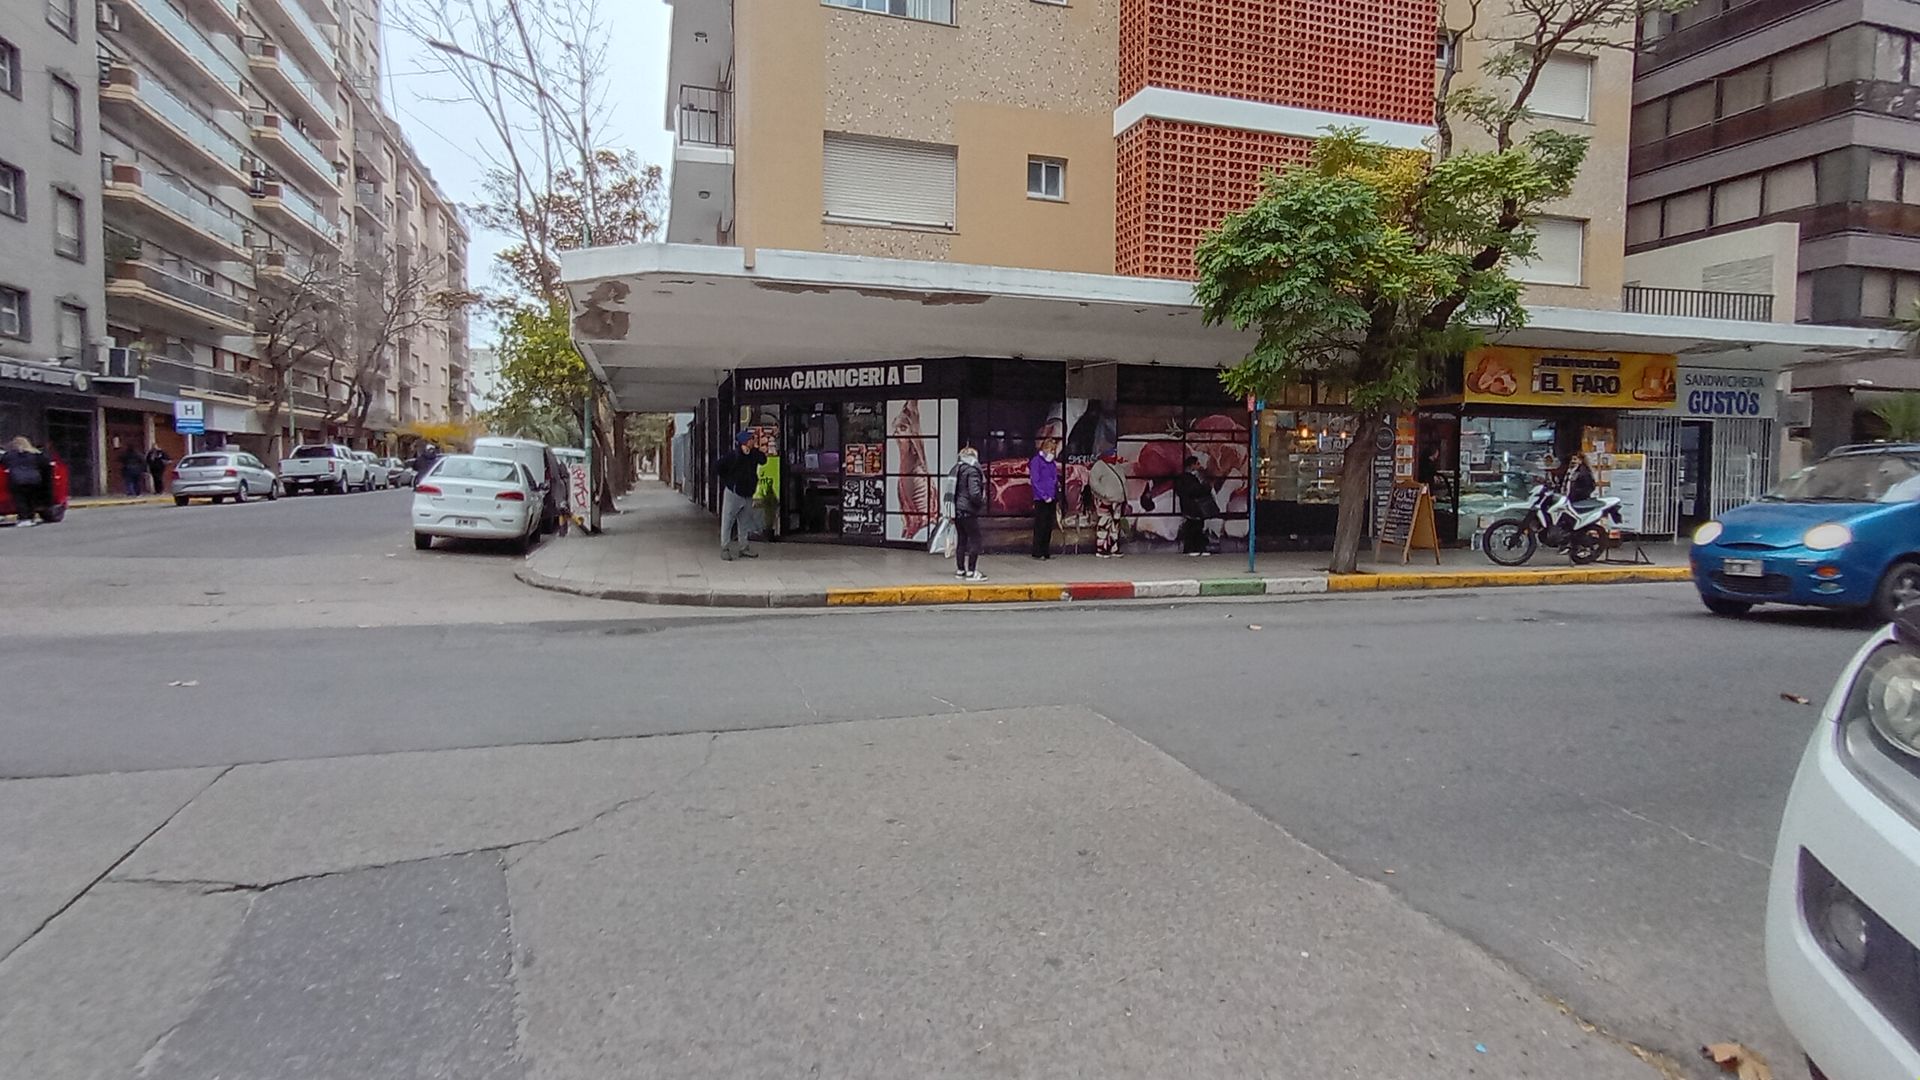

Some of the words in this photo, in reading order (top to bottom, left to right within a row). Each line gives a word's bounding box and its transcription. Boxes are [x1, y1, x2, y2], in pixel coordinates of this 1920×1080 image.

[744, 377, 791, 391] NONINA
[1541, 372, 1565, 392] EL
[1572, 374, 1621, 394] FARO
[1684, 374, 1765, 388] SANDWICHERIA
[1688, 389, 1760, 415] GUSTO'S
[184, 404, 195, 415] H
